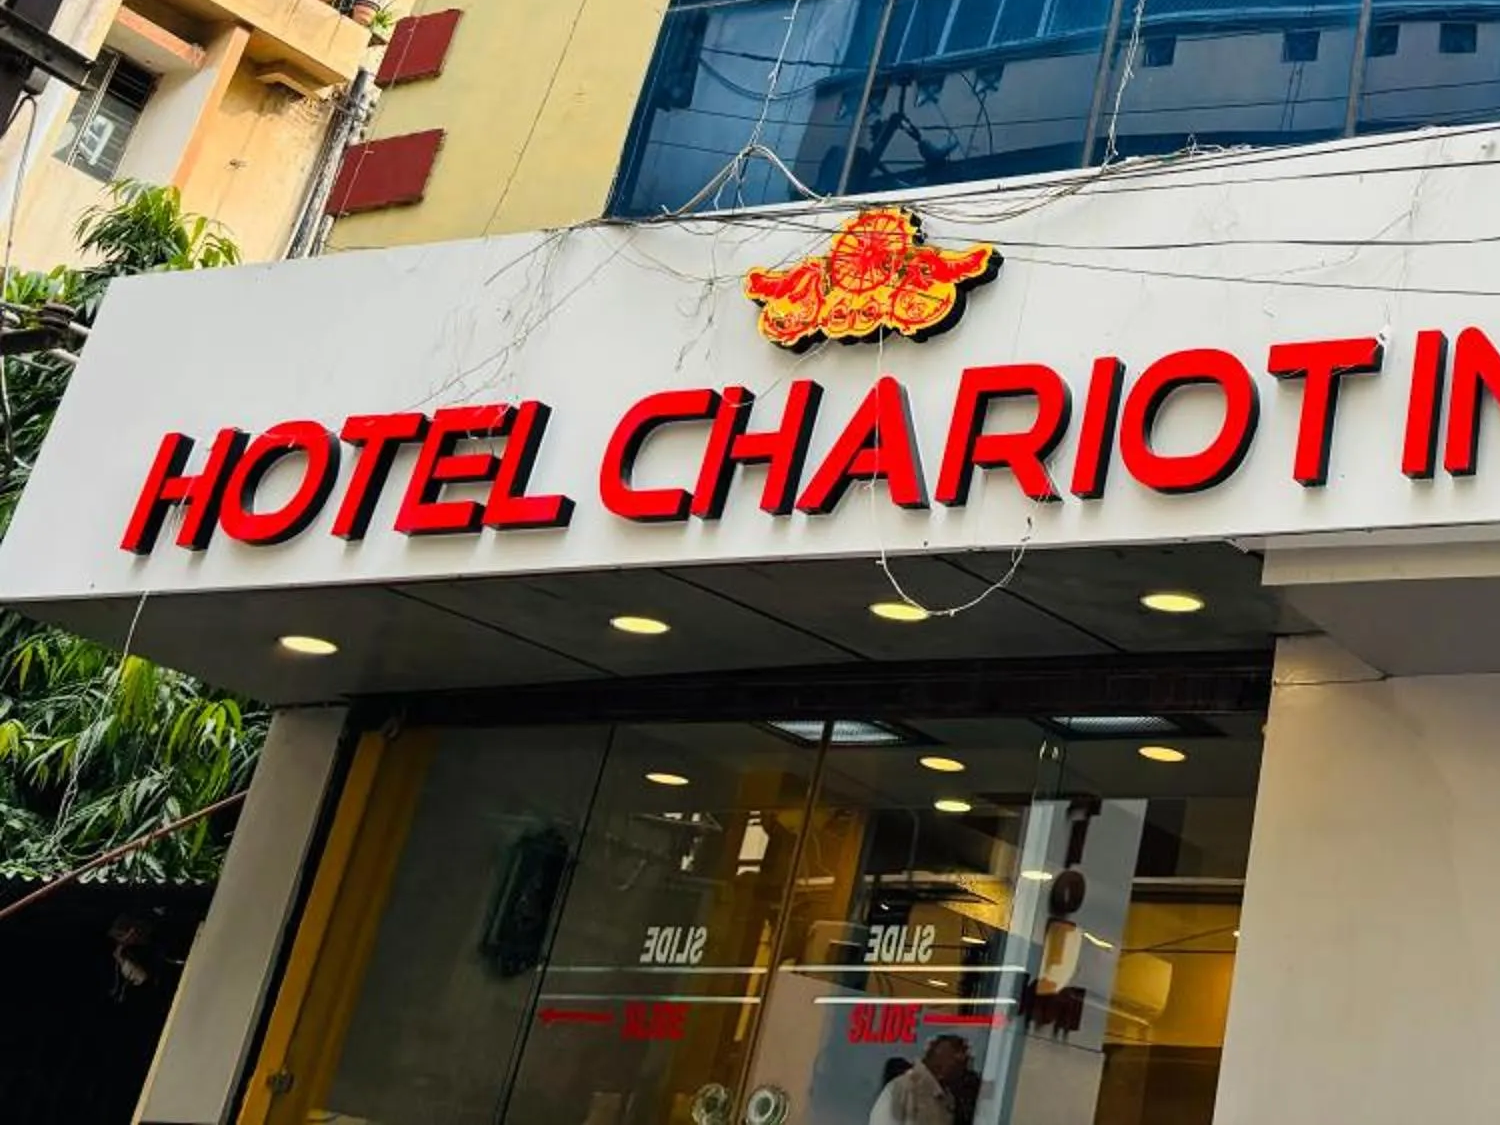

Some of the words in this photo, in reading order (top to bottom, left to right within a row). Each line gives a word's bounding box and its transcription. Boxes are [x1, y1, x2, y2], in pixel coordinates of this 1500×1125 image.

[121, 400, 573, 555] HOTEL
[600, 336, 1384, 520] CHARIOT
[847, 1002, 922, 1044] SLIDE
